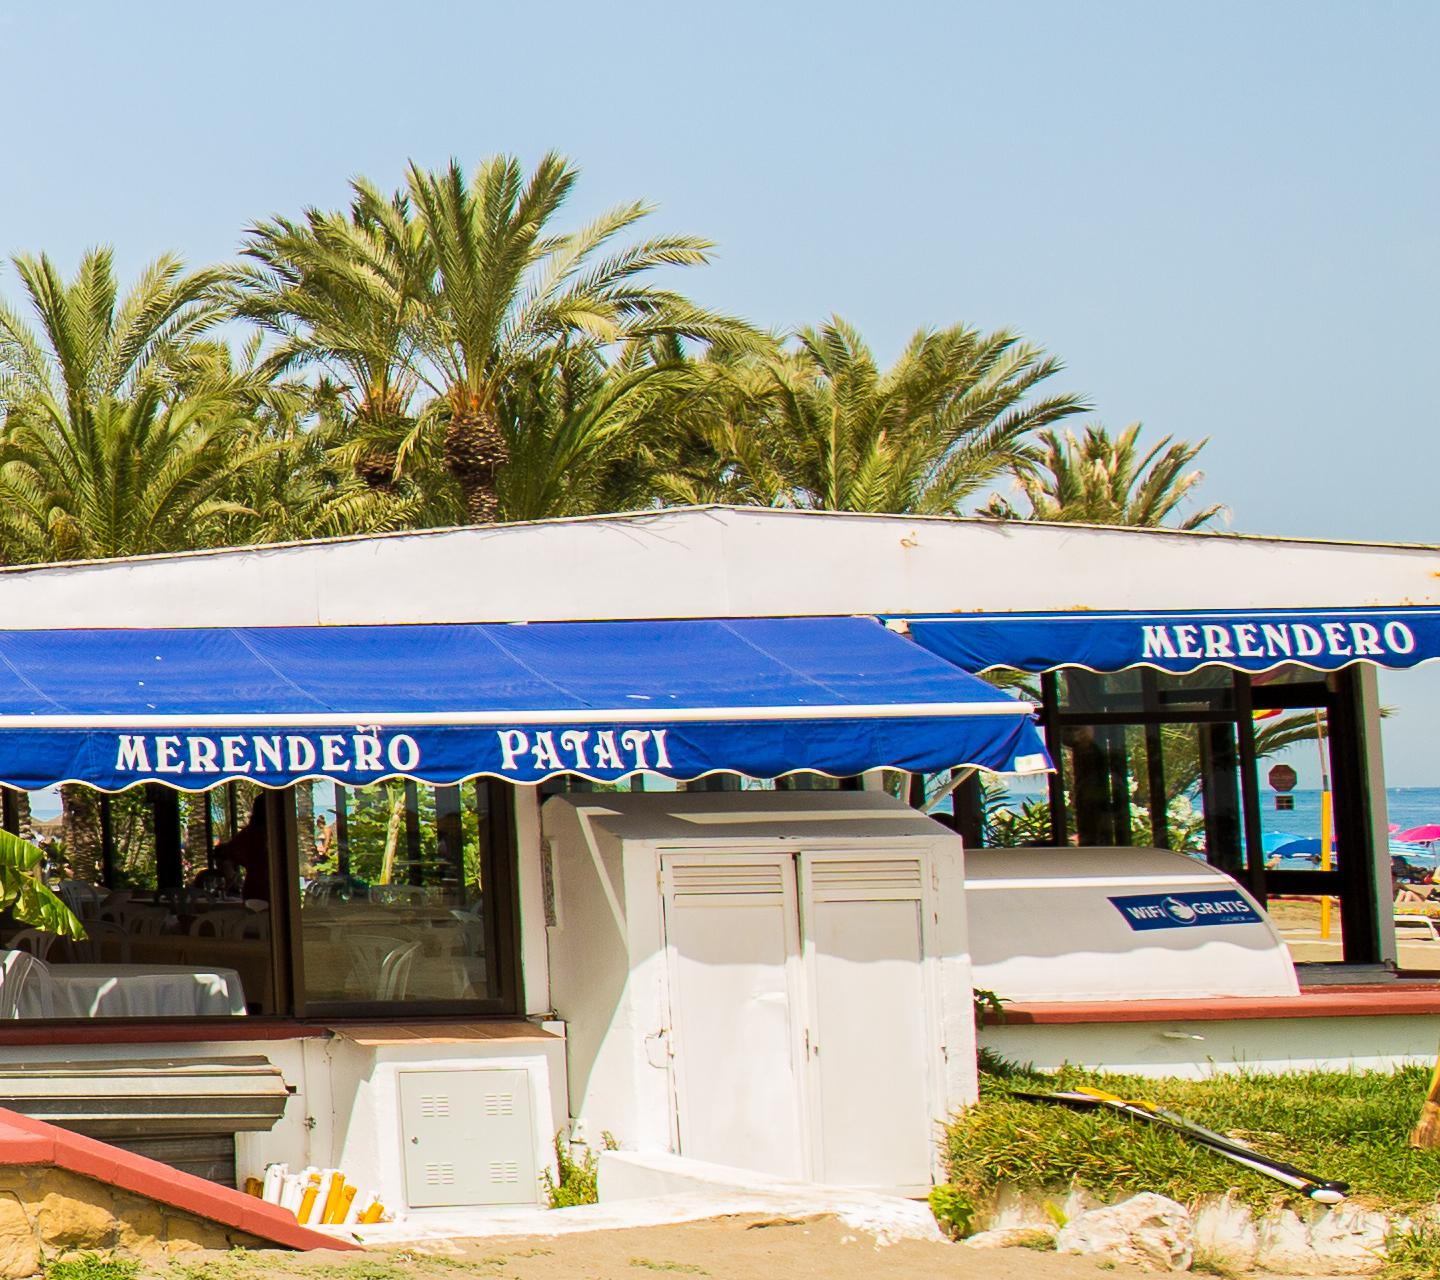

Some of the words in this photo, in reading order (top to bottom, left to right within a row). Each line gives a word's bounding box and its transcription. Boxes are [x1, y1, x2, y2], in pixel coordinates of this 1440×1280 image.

[1141, 621, 1415, 658] MERENDERO
[115, 733, 421, 774] MERENDERO
[497, 729, 671, 772] PATATI
[1191, 900, 1250, 915] GRATIS
